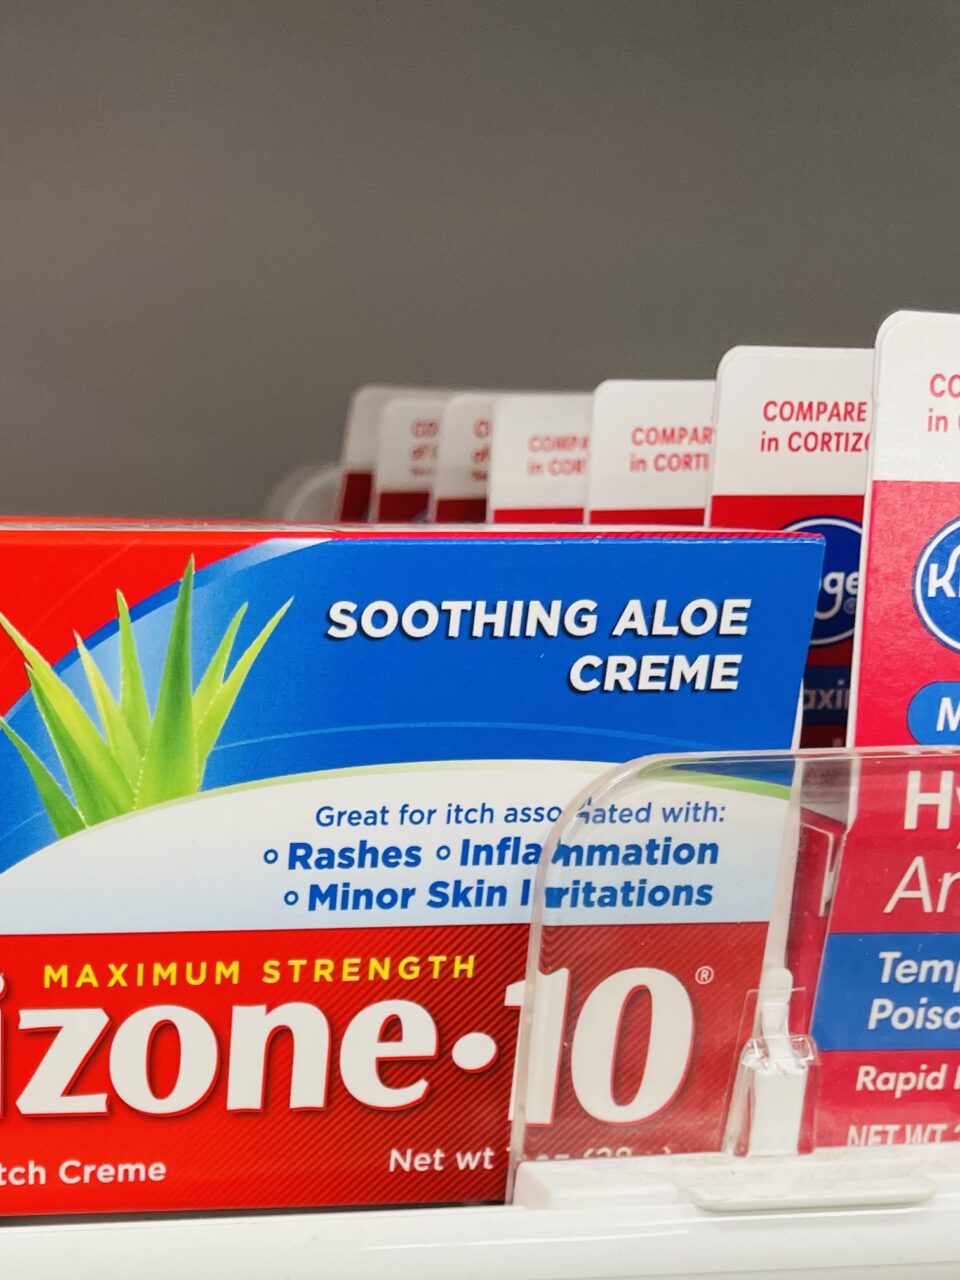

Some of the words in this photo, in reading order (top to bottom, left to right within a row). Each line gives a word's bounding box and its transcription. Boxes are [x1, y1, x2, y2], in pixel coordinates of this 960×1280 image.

[763, 401, 867, 422] COMPARE
[760, 432, 782, 453] in
[327, 600, 598, 639] SOOTHING
[612, 599, 752, 637] ALOE
[570, 654, 743, 692] CREME
[315, 805, 390, 828] Great
[399, 804, 437, 827] for
[446, 802, 495, 826] itch
[504, 798, 652, 824] assoated
[662, 801, 726, 823] with:
[288, 838, 423, 871] Rashes
[308, 882, 417, 911] Minor
[428, 880, 508, 910] Skin
[43, 961, 240, 989] MAXIMUM
[262, 955, 477, 983] STRENGTH
[856, 1063, 949, 1099] Rapid
[58, 1160, 167, 1186] Creme
[388, 1148, 444, 1173] Net
[456, 1147, 494, 1171] wt
